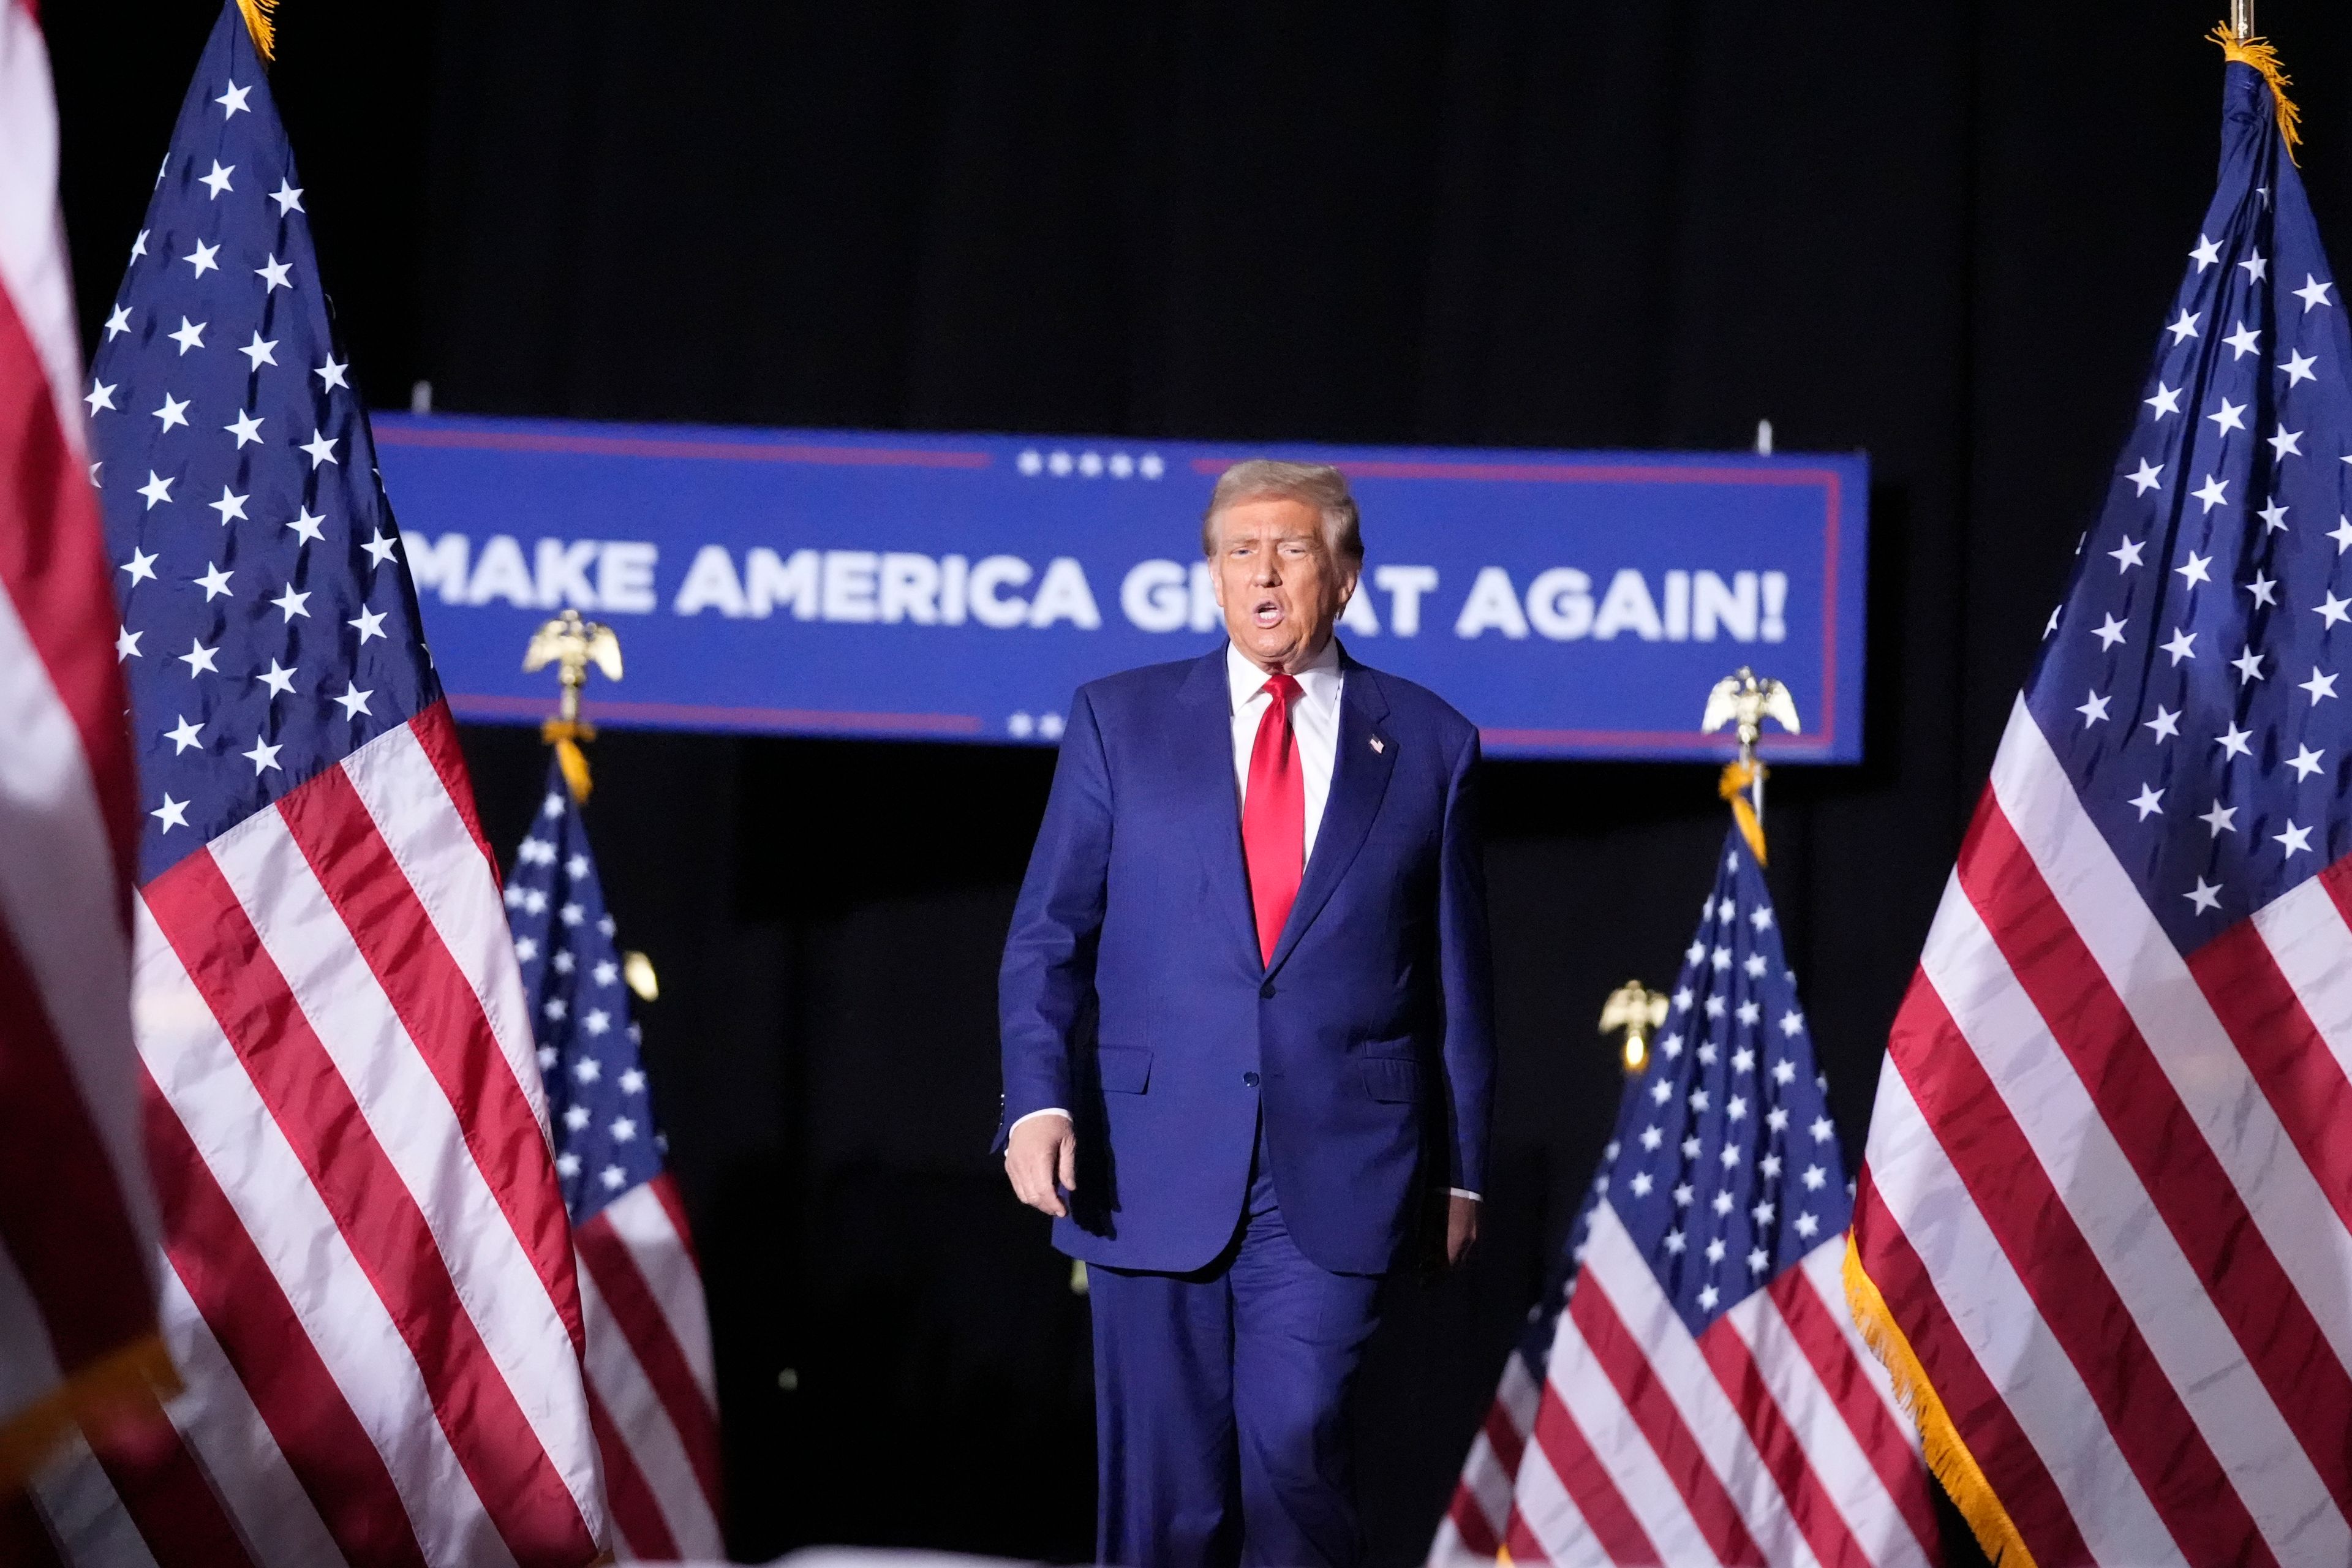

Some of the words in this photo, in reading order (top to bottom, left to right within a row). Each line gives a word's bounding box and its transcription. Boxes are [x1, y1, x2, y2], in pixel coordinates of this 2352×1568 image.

[399, 530, 658, 612] MAKE
[674, 545, 1101, 630] AMERICA
[1120, 557, 1439, 637] GAT
[1455, 566, 1788, 642] AGAIN!
